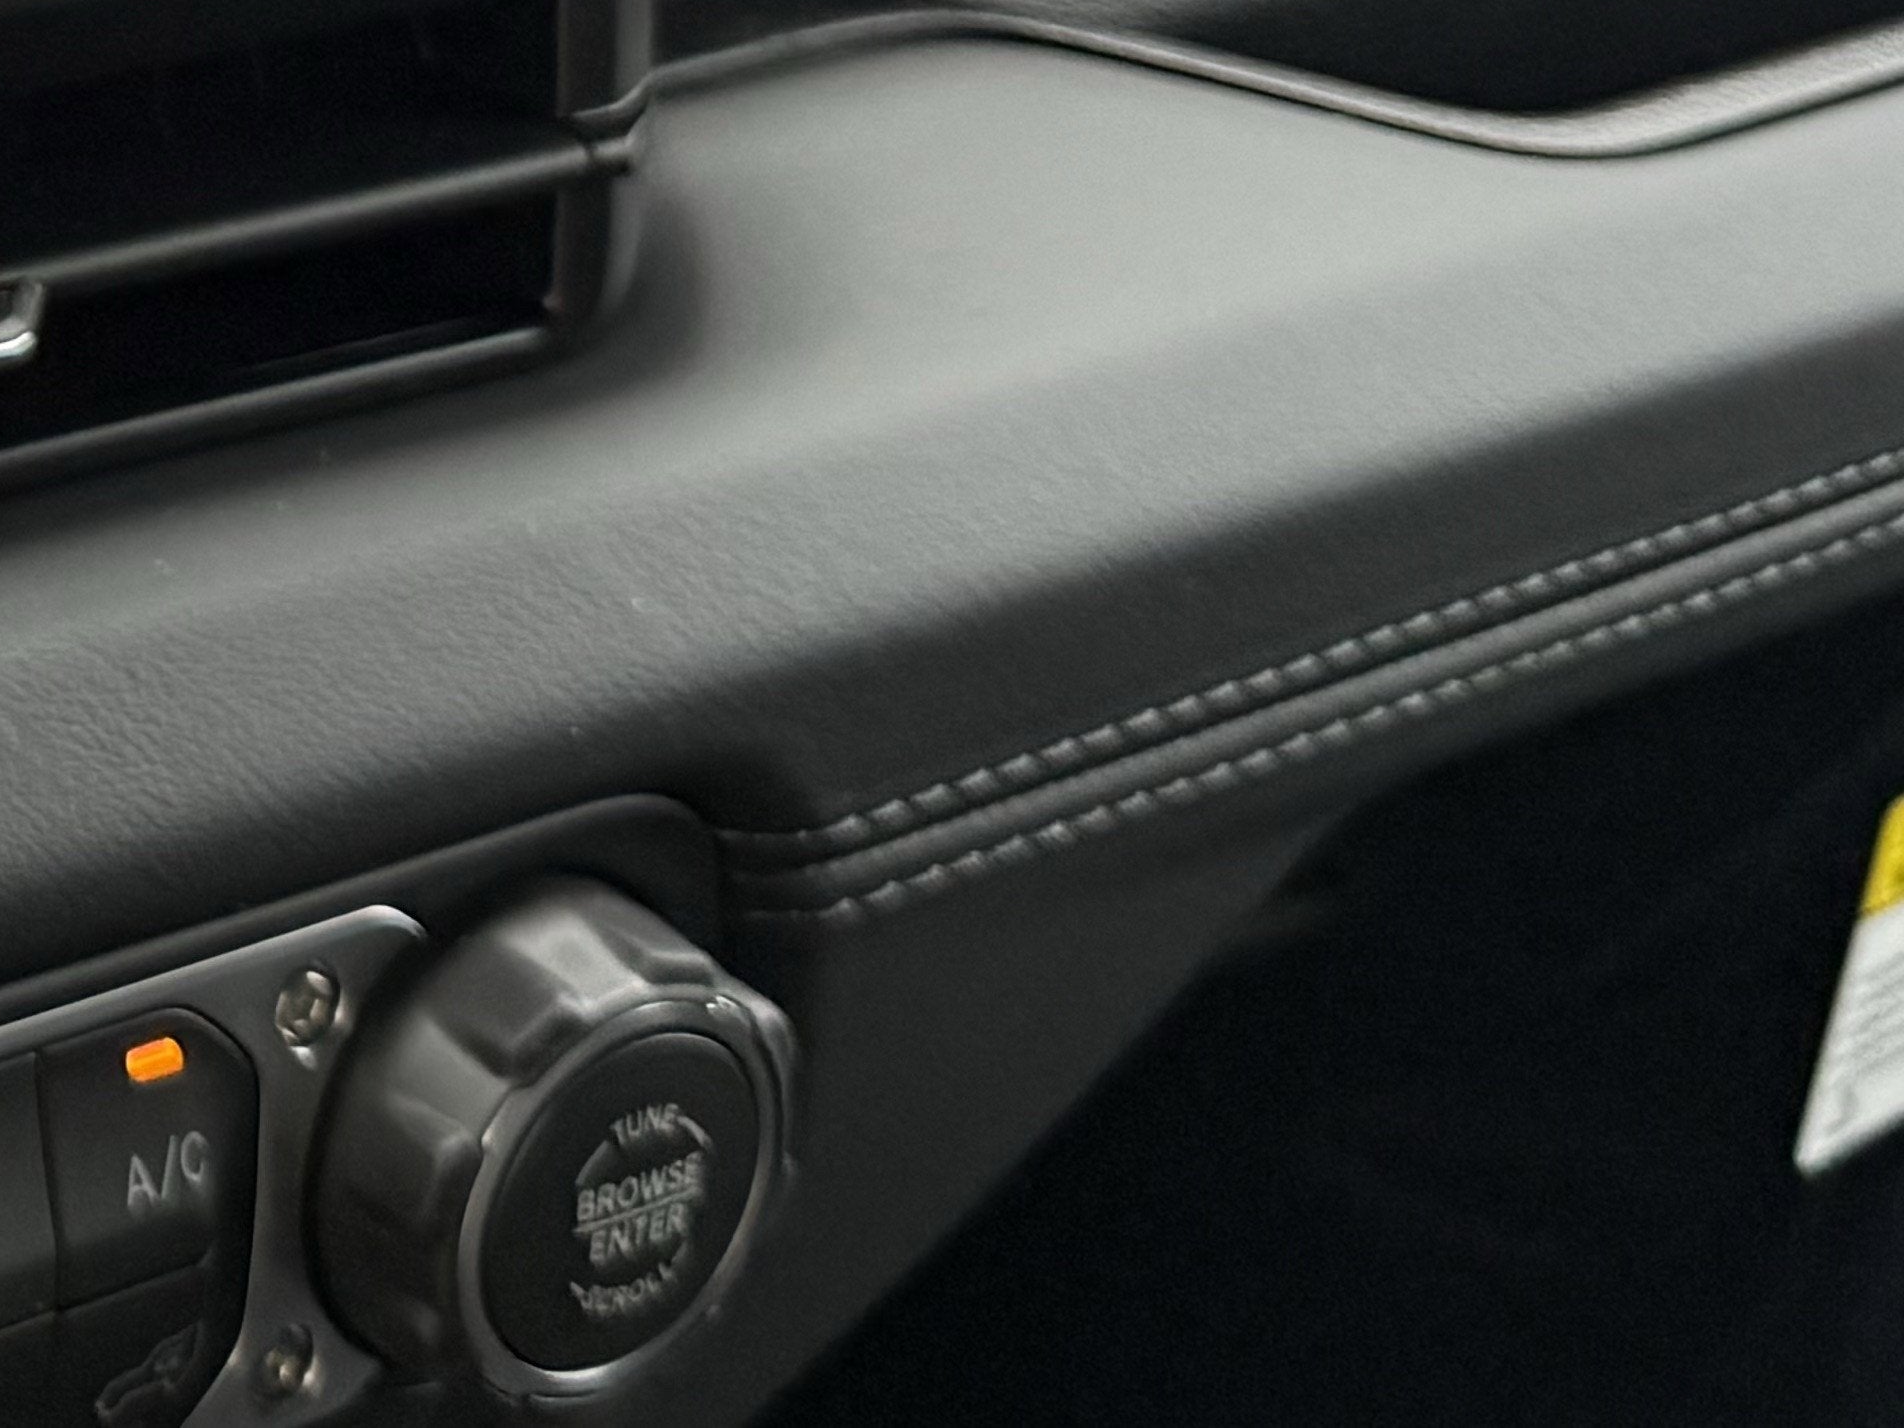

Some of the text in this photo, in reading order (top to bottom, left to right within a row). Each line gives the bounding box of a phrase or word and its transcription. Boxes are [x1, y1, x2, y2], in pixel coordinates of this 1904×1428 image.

[609, 1102, 680, 1144] TUNE
[126, 1130, 209, 1210] A/C
[576, 1151, 703, 1223] BROWSE
[589, 1201, 689, 1265] ENTER
